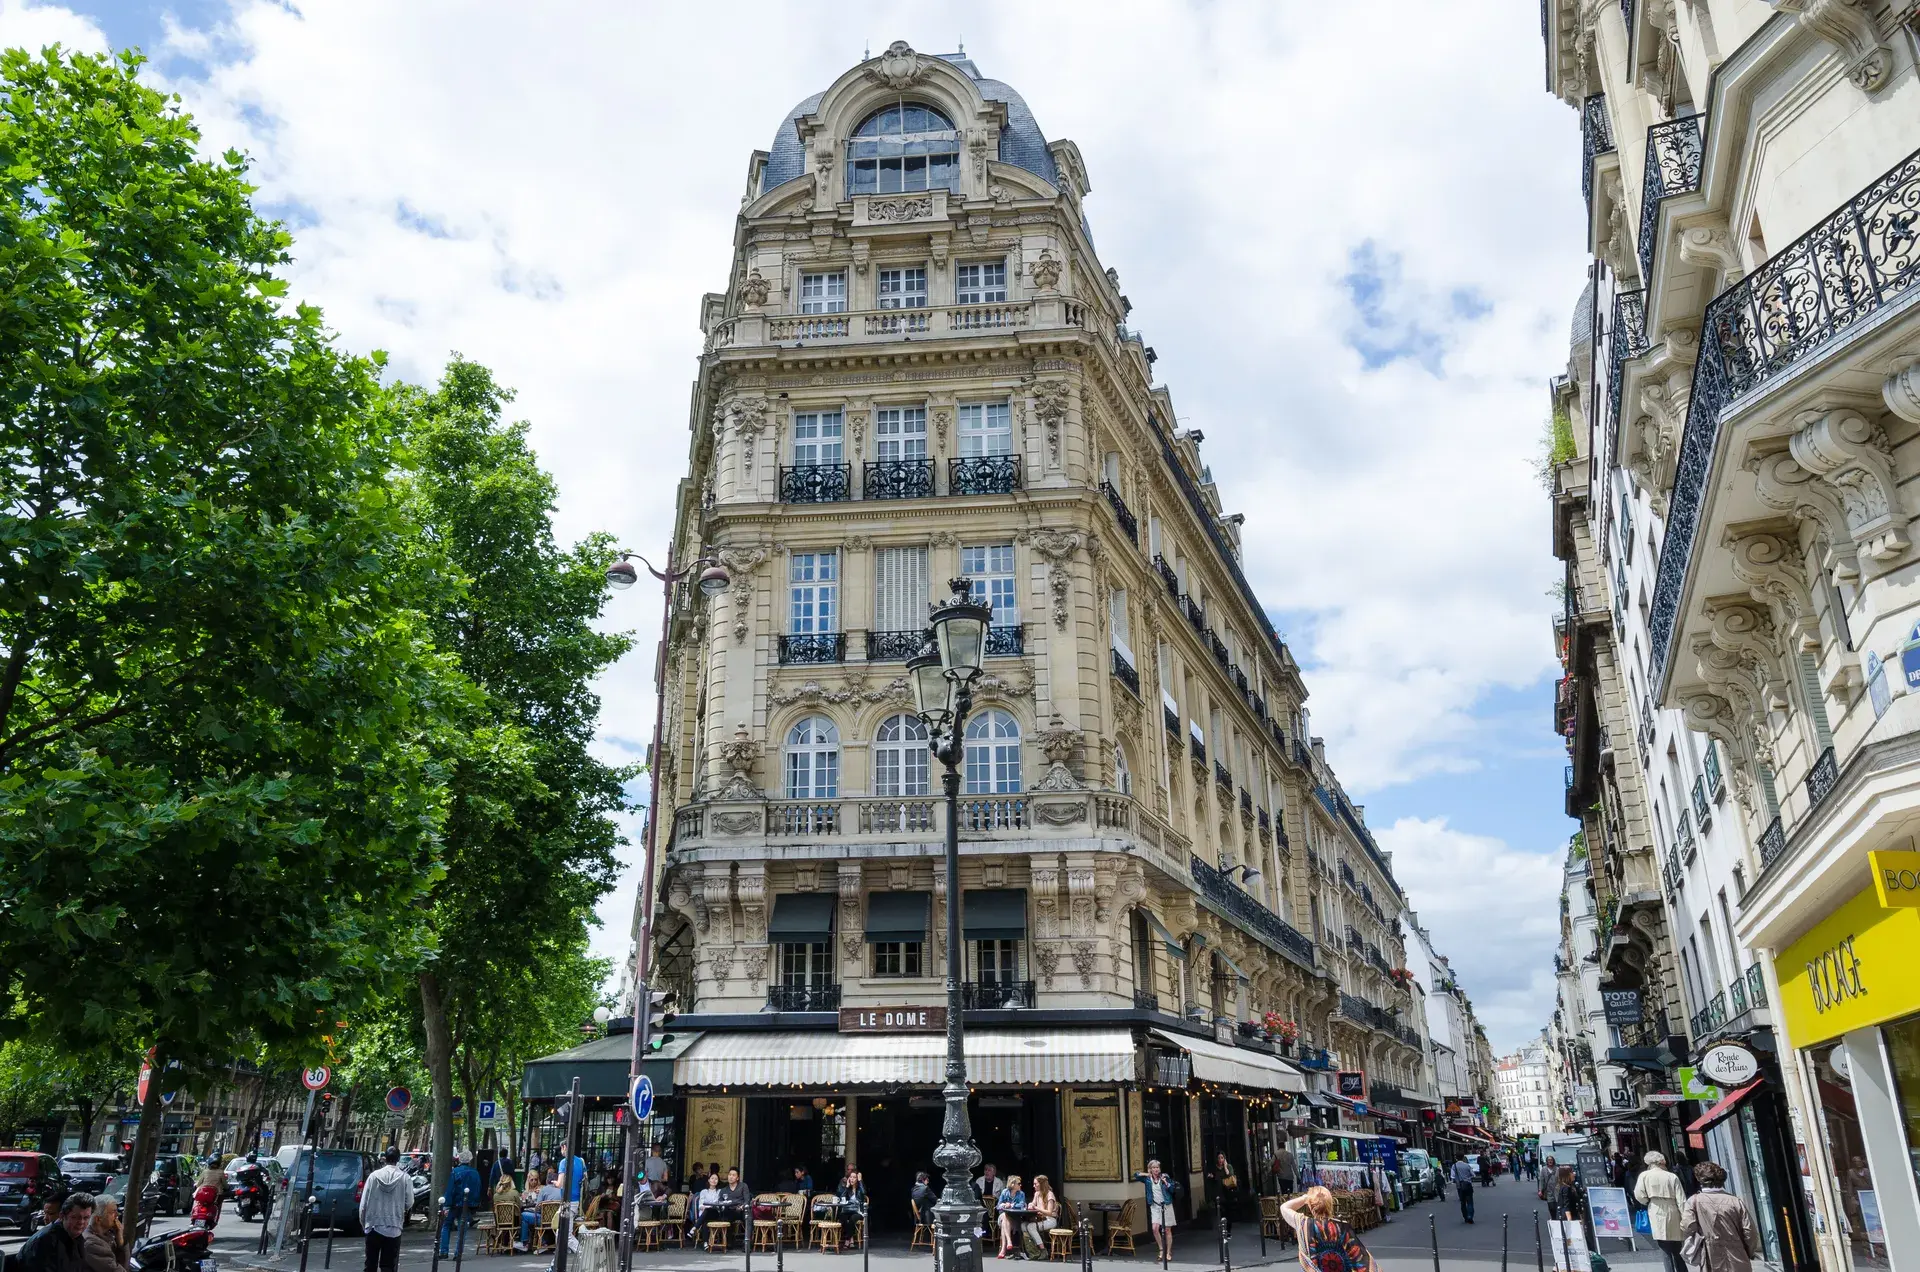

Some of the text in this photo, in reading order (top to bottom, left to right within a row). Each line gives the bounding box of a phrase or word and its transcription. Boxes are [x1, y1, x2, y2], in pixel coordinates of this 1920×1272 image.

[1883, 869, 1920, 891] BO
[1806, 934, 1868, 1014] BOCAGE
[1604, 991, 1637, 1001] FOTO
[860, 1012, 927, 1026] LE DOME
[1715, 1051, 1740, 1063] Ronde
[1715, 1061, 1749, 1073] des Pains
[308, 1070, 324, 1082] 30
[483, 1104, 491, 1117] P
